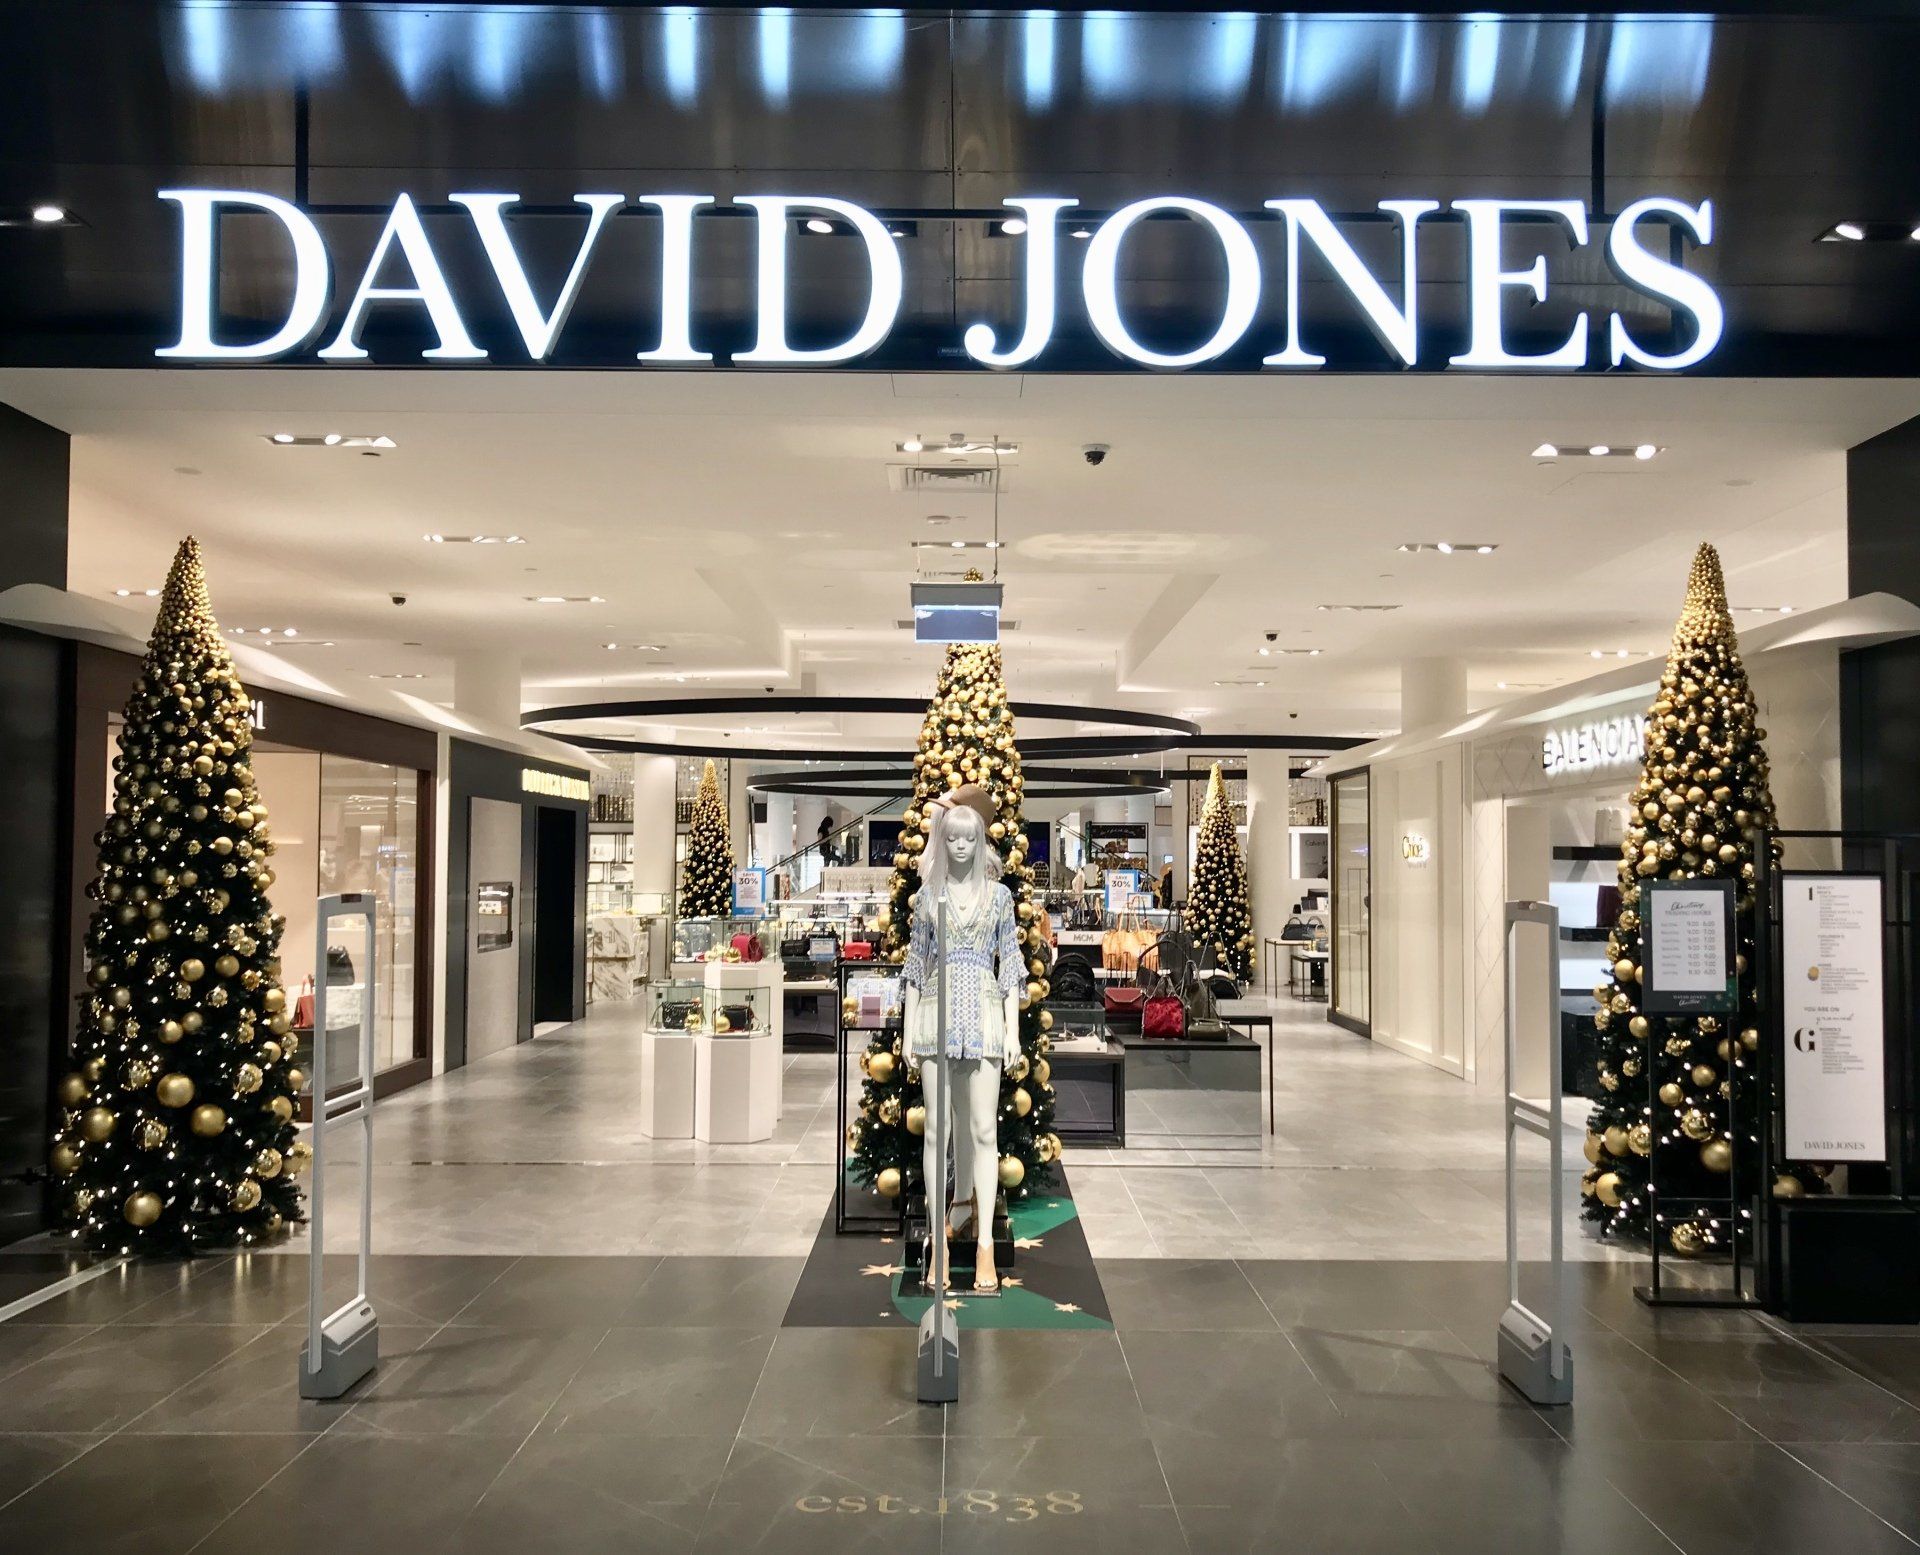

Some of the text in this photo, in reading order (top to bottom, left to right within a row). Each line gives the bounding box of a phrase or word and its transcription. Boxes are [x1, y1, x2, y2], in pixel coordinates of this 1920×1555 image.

[155, 190, 1722, 369] DAVID JONES
[738, 877, 759, 885] 30%
[1111, 880, 1131, 888] 30%
[1073, 933, 1094, 943] MCM
[1793, 1027, 1815, 1052] G
[1804, 1141, 1865, 1150] DAVID JONES
